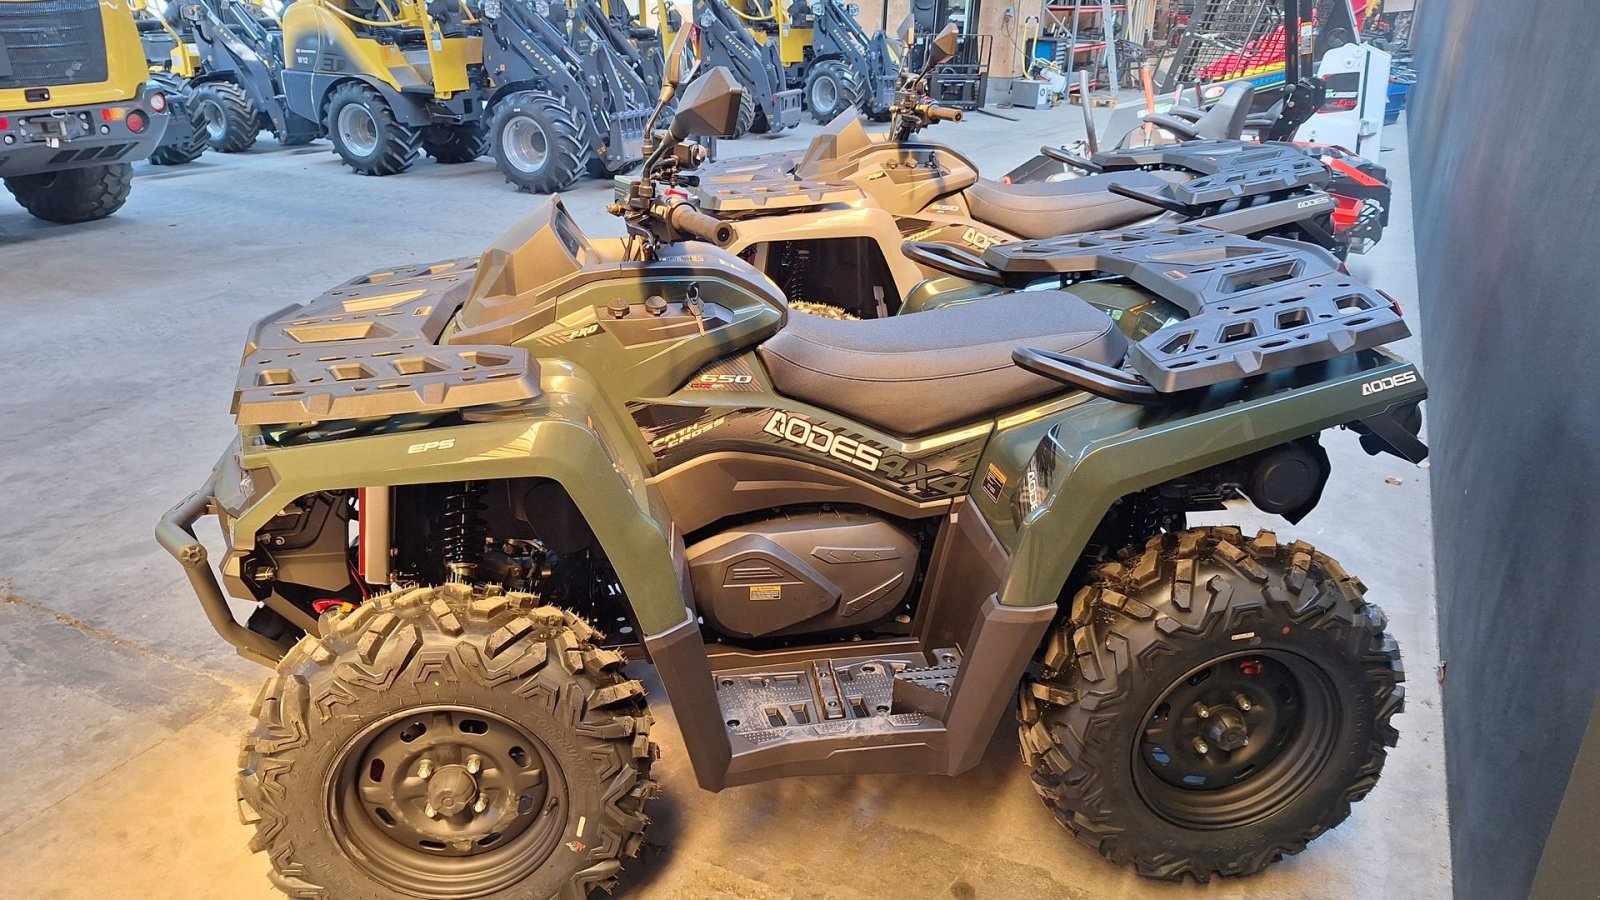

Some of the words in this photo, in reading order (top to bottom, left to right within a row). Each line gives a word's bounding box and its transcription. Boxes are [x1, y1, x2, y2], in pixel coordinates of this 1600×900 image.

[520, 39, 557, 75] Eurotrac
[1297, 196, 1329, 209] AODES
[569, 324, 599, 339] PRO
[700, 374, 753, 384] 650
[1362, 370, 1417, 396] AODES
[667, 416, 726, 449] CROSS
[763, 411, 883, 472] AODES
[407, 438, 457, 454] EPS
[1027, 471, 1040, 512] AODE
